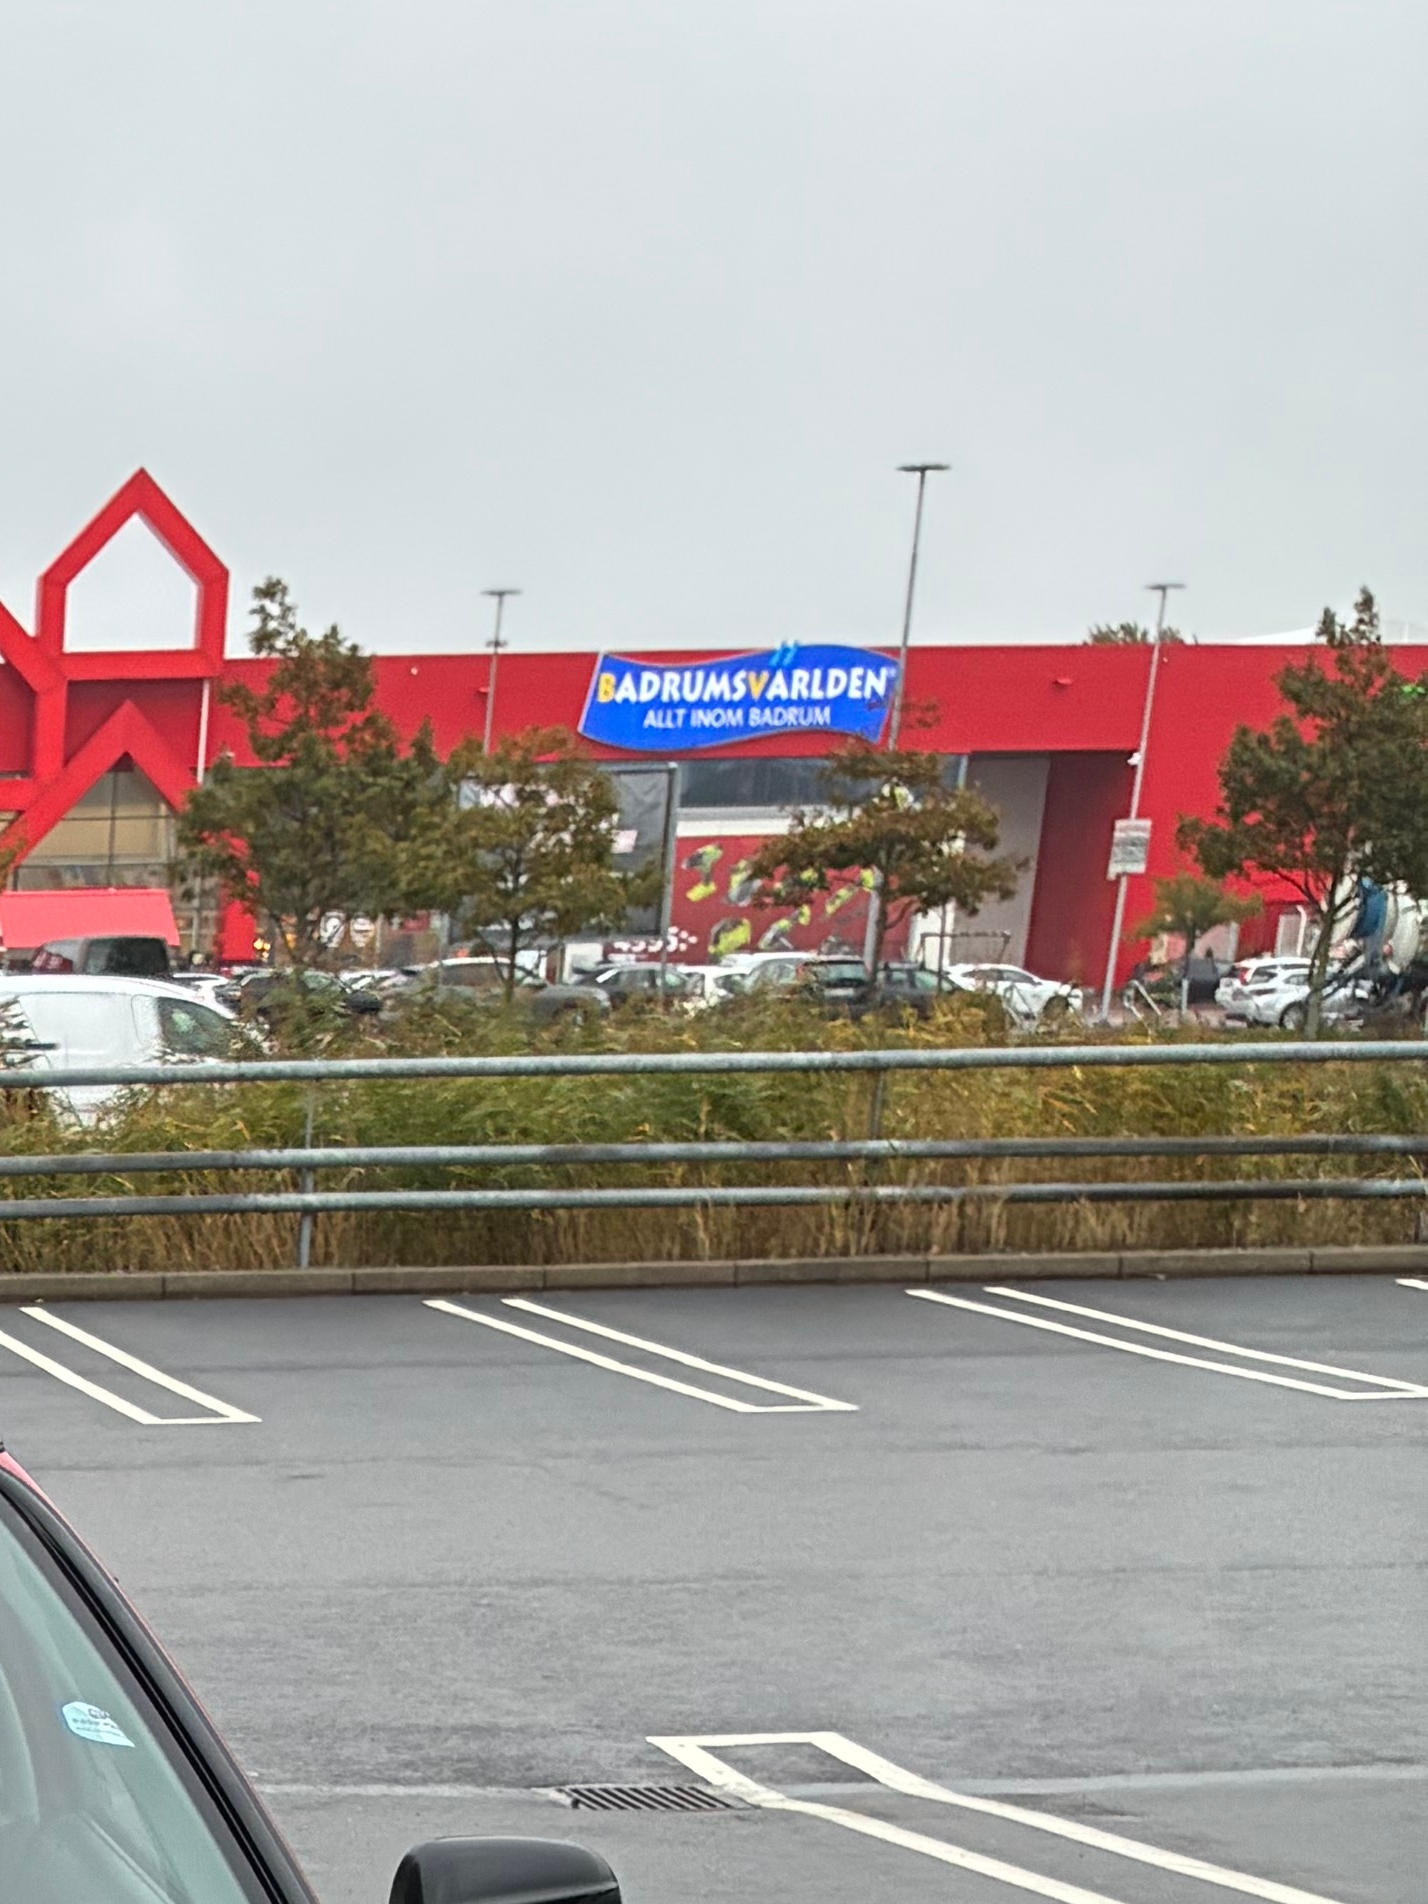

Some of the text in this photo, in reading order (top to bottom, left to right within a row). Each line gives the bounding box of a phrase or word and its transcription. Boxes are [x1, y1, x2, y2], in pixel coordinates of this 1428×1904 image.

[643, 705, 831, 729] ALLT INOM BADRUM
